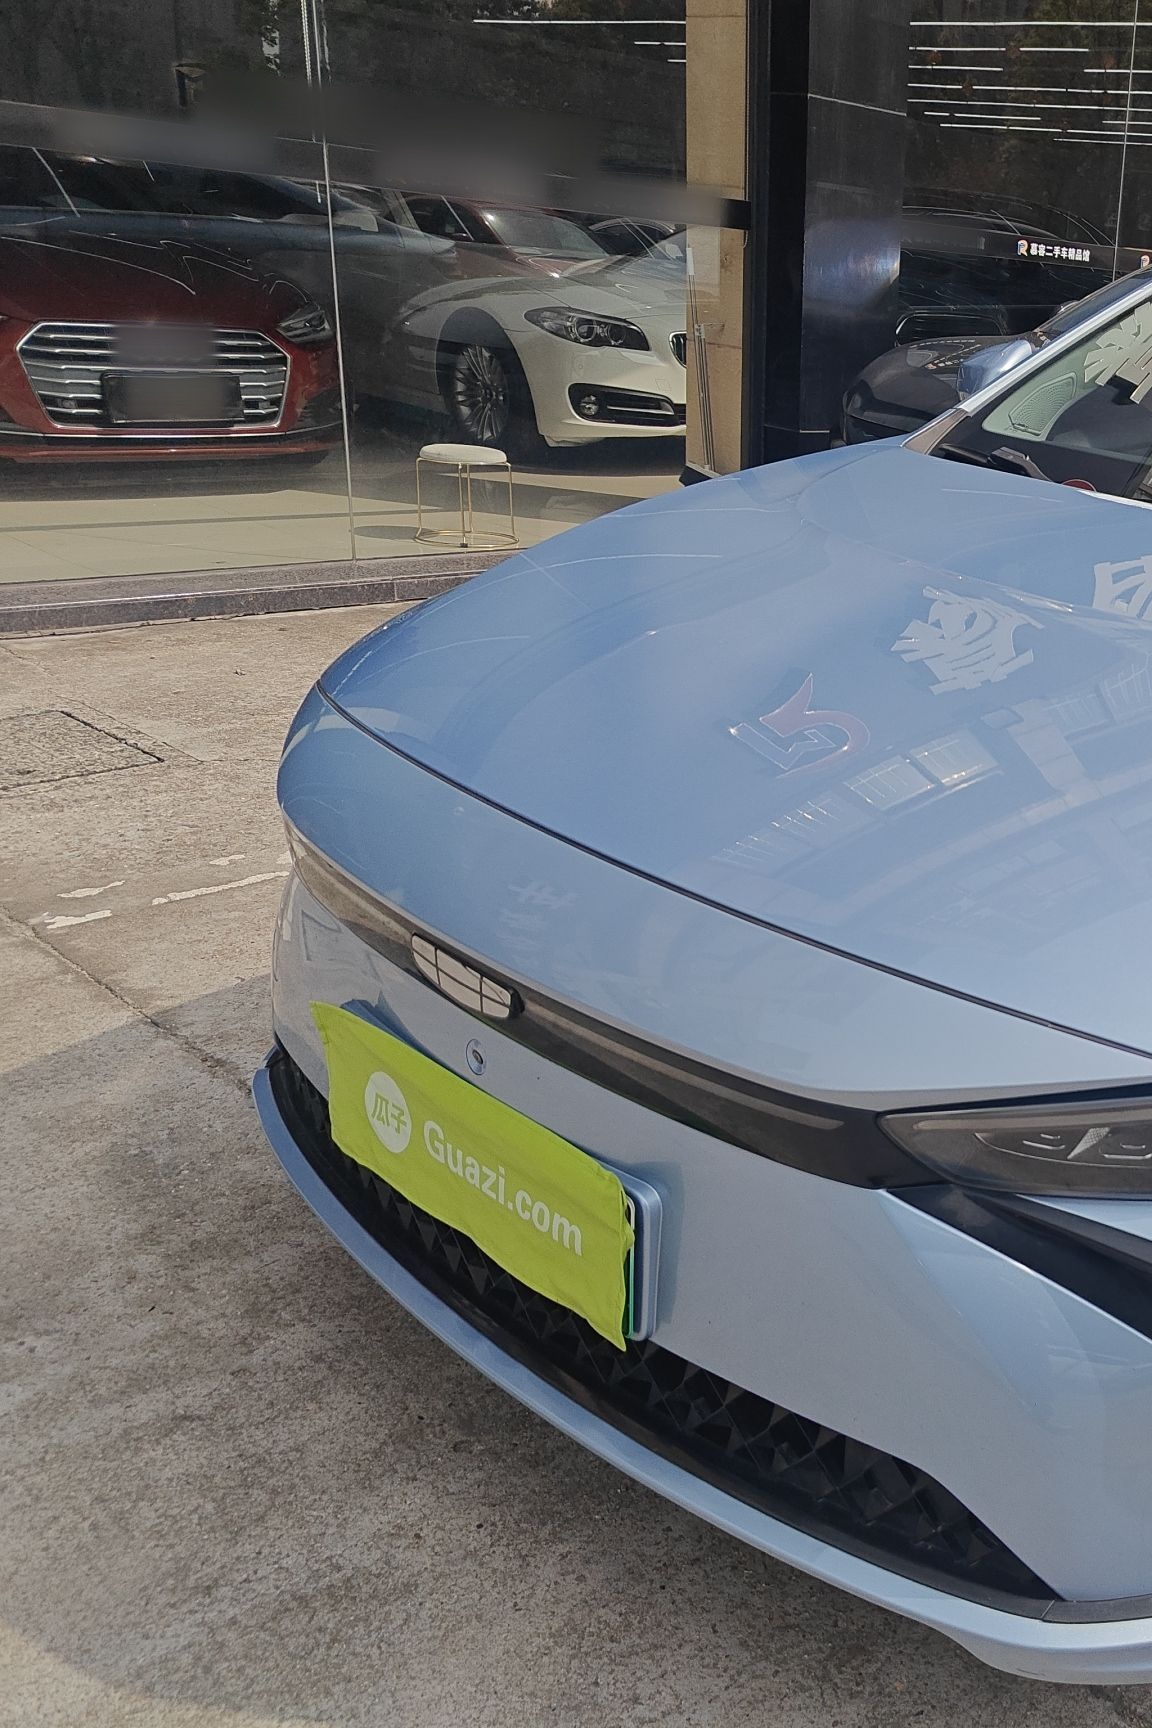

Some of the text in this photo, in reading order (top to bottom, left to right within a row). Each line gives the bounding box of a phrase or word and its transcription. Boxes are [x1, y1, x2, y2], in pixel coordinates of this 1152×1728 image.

[1029, 242, 1091, 262] 慕客二手车精品馆
[371, 1091, 583, 1257] 瓜子 Guazi.com
